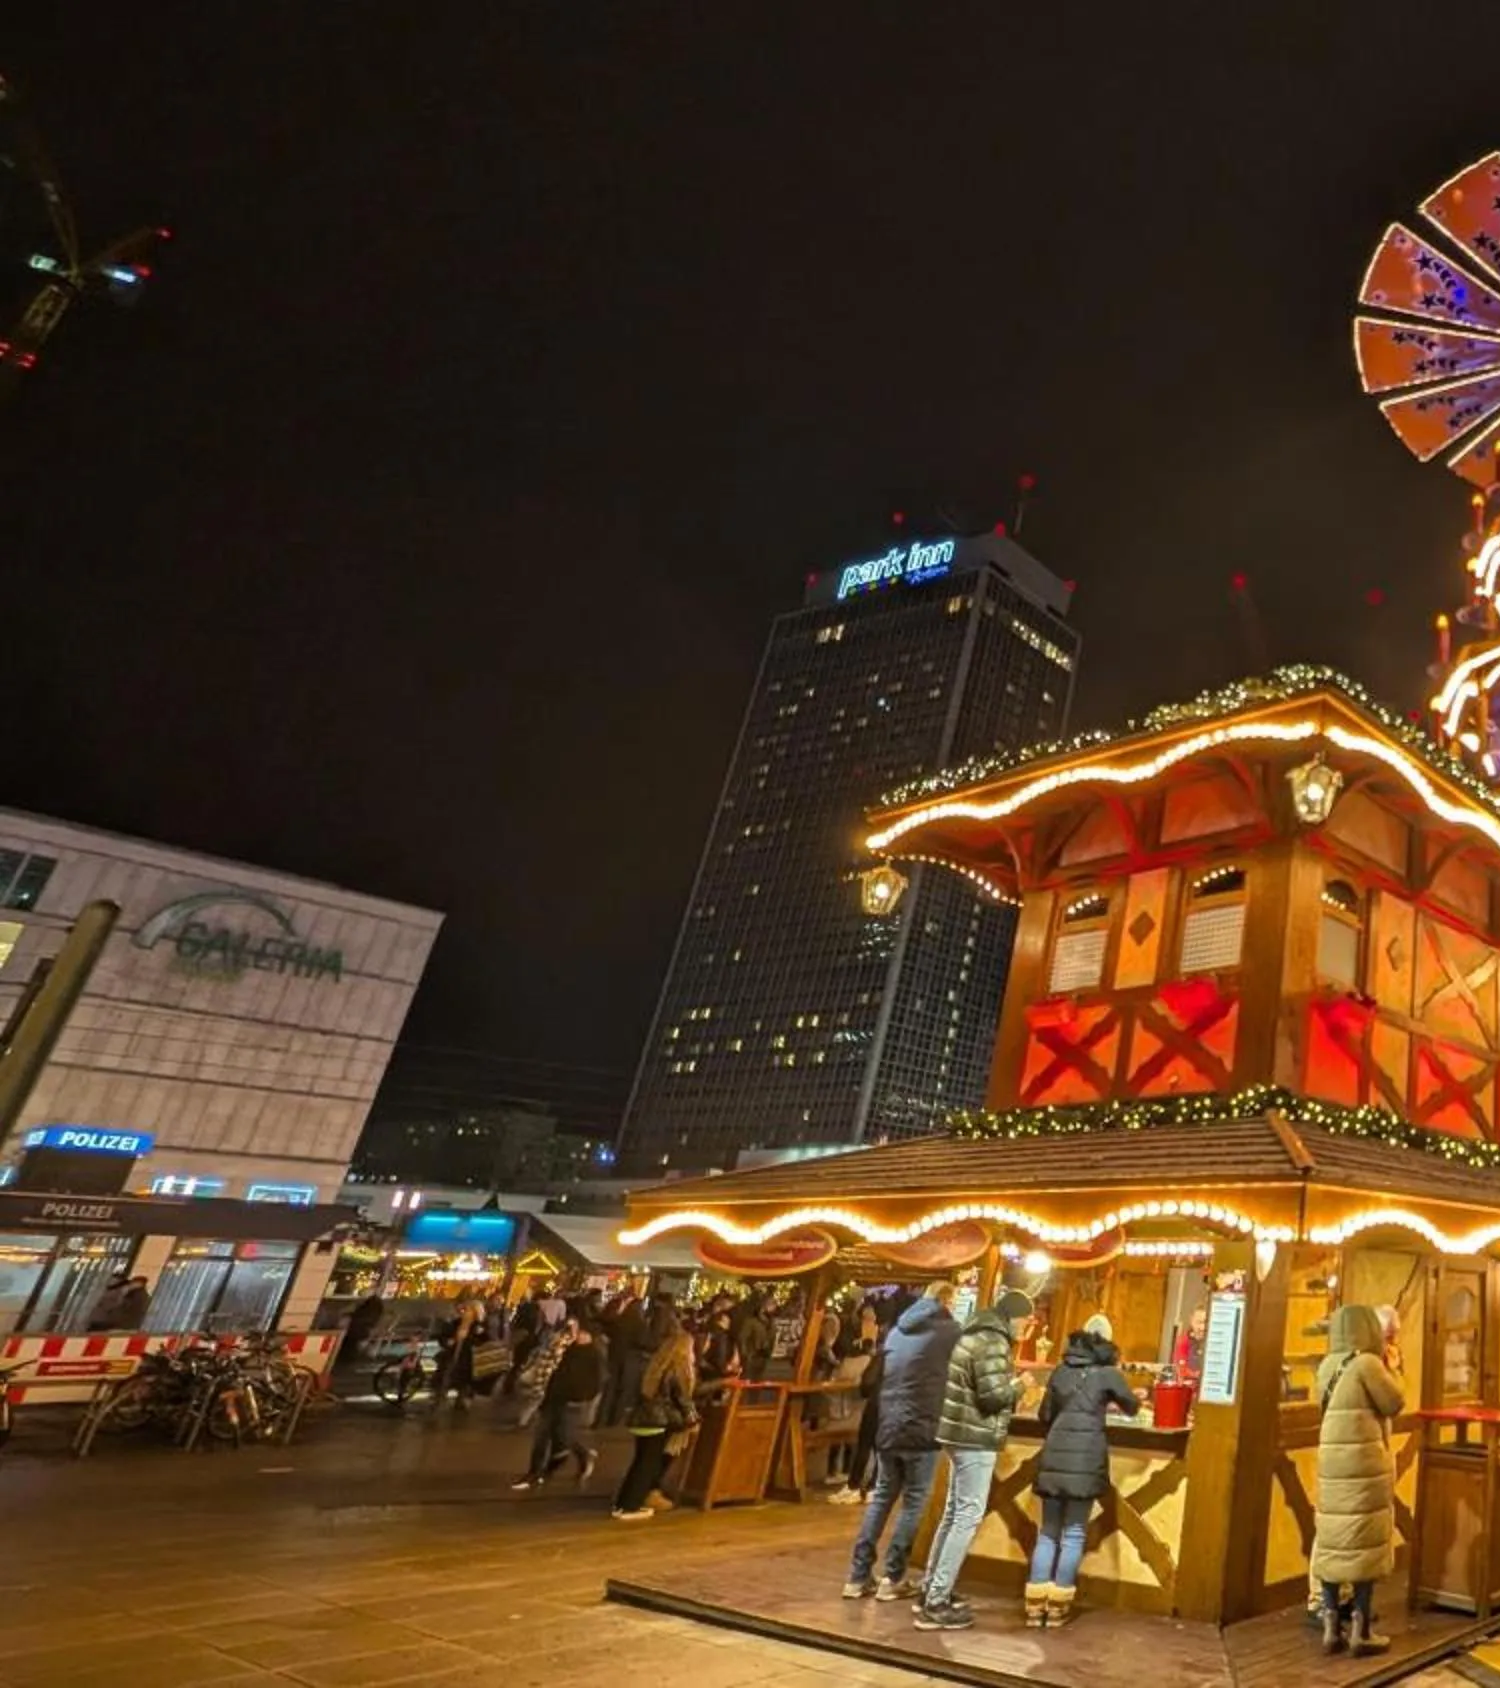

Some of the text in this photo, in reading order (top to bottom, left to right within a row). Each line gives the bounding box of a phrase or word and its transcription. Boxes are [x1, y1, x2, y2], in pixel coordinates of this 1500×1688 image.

[837, 547, 905, 599] park
[906, 541, 955, 572] inn
[177, 922, 343, 984] GALERIA
[59, 1131, 140, 1152] POLIZEI
[42, 1202, 114, 1220] POLIZEI
